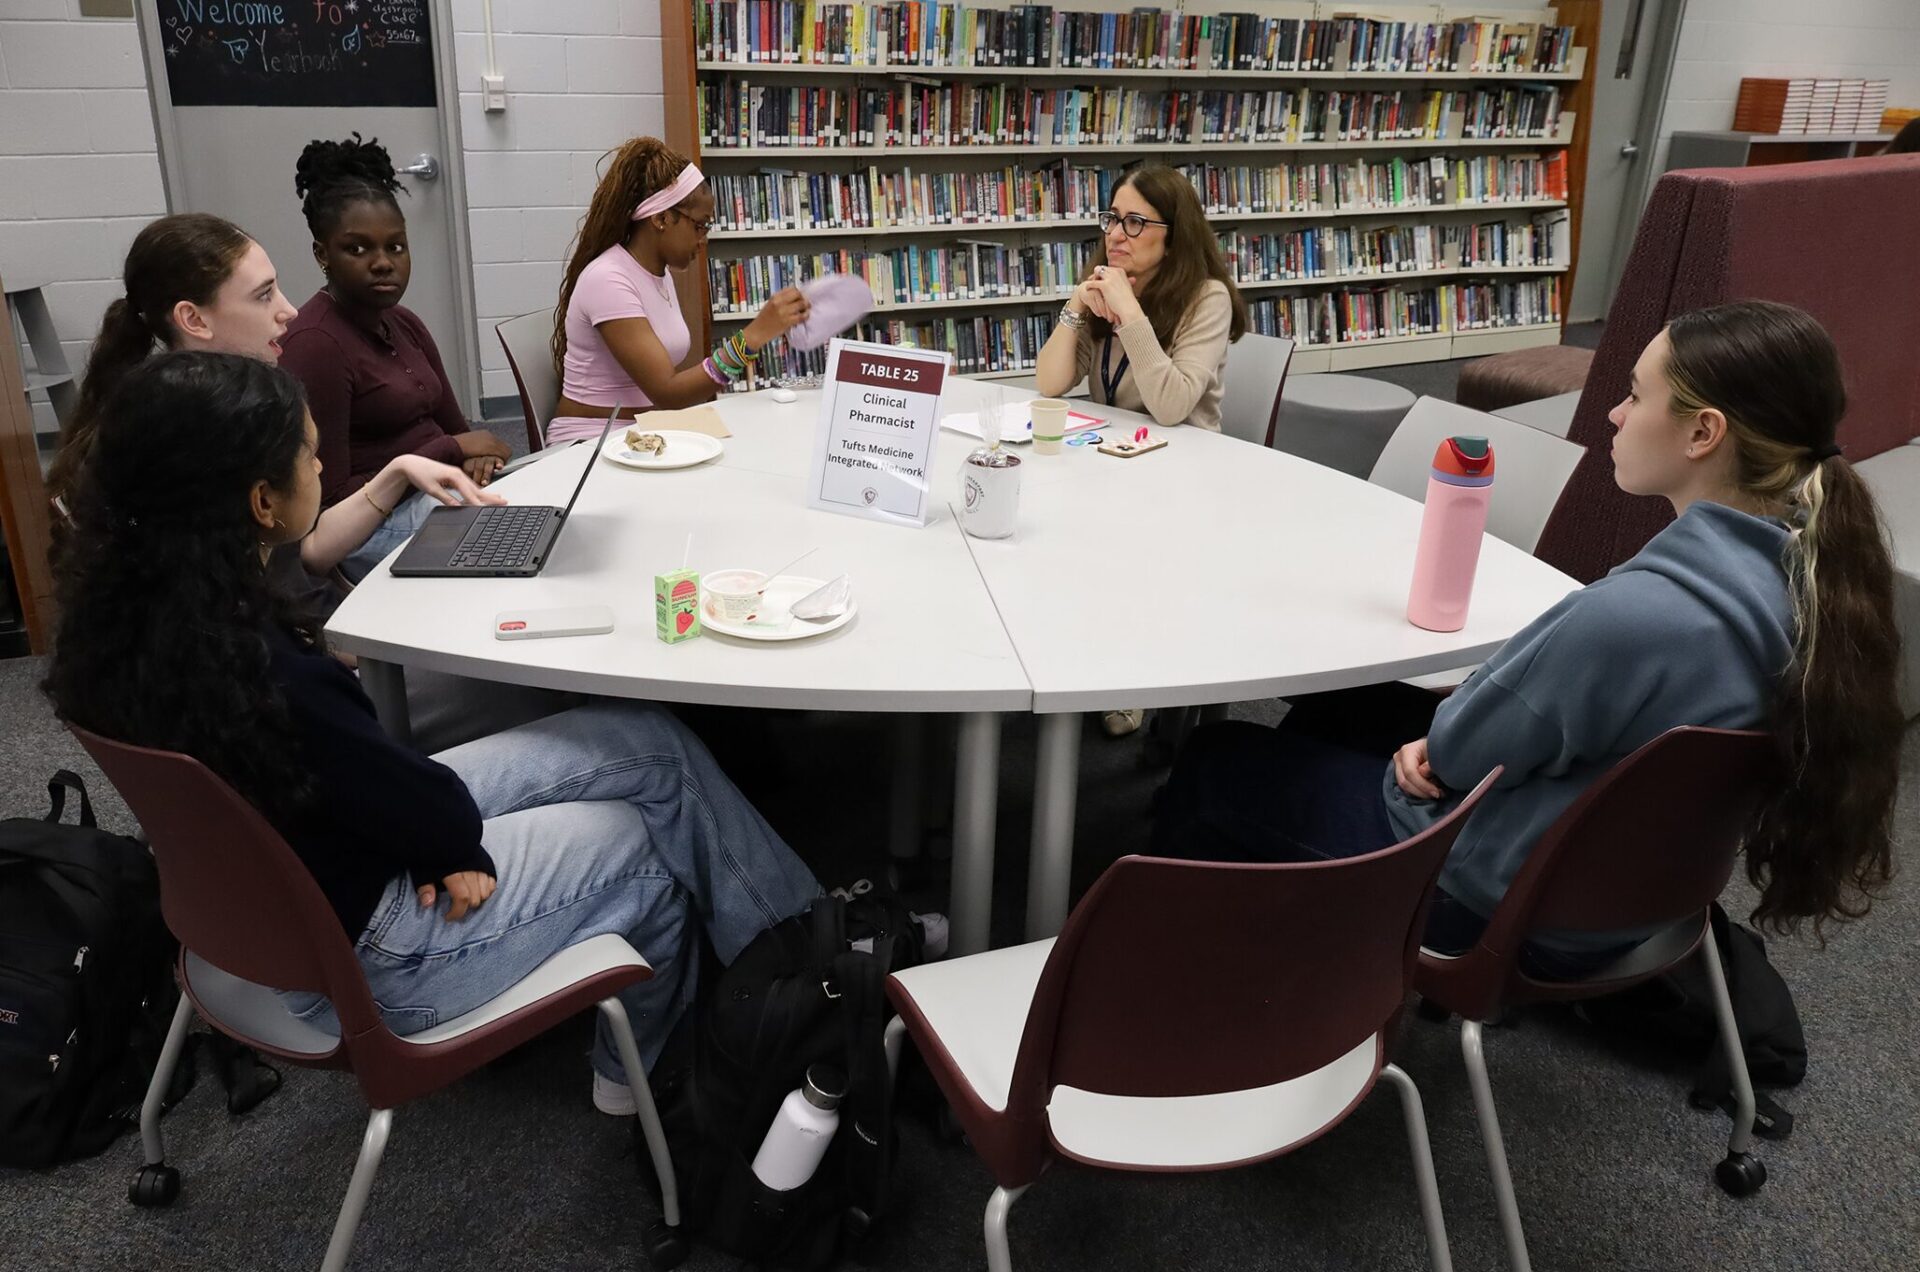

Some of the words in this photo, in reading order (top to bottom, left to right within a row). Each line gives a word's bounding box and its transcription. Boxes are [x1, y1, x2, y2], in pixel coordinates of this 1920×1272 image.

[176, 0, 285, 25] Welcome
[380, 13, 417, 25] Code
[860, 362, 901, 380] TABLE
[903, 368, 920, 382] 25
[863, 392, 908, 410] Clinical
[849, 408, 916, 430] Pharmacist
[841, 439, 866, 452] Tufts
[868, 444, 914, 460] Medicine
[828, 453, 878, 470] Integrated
